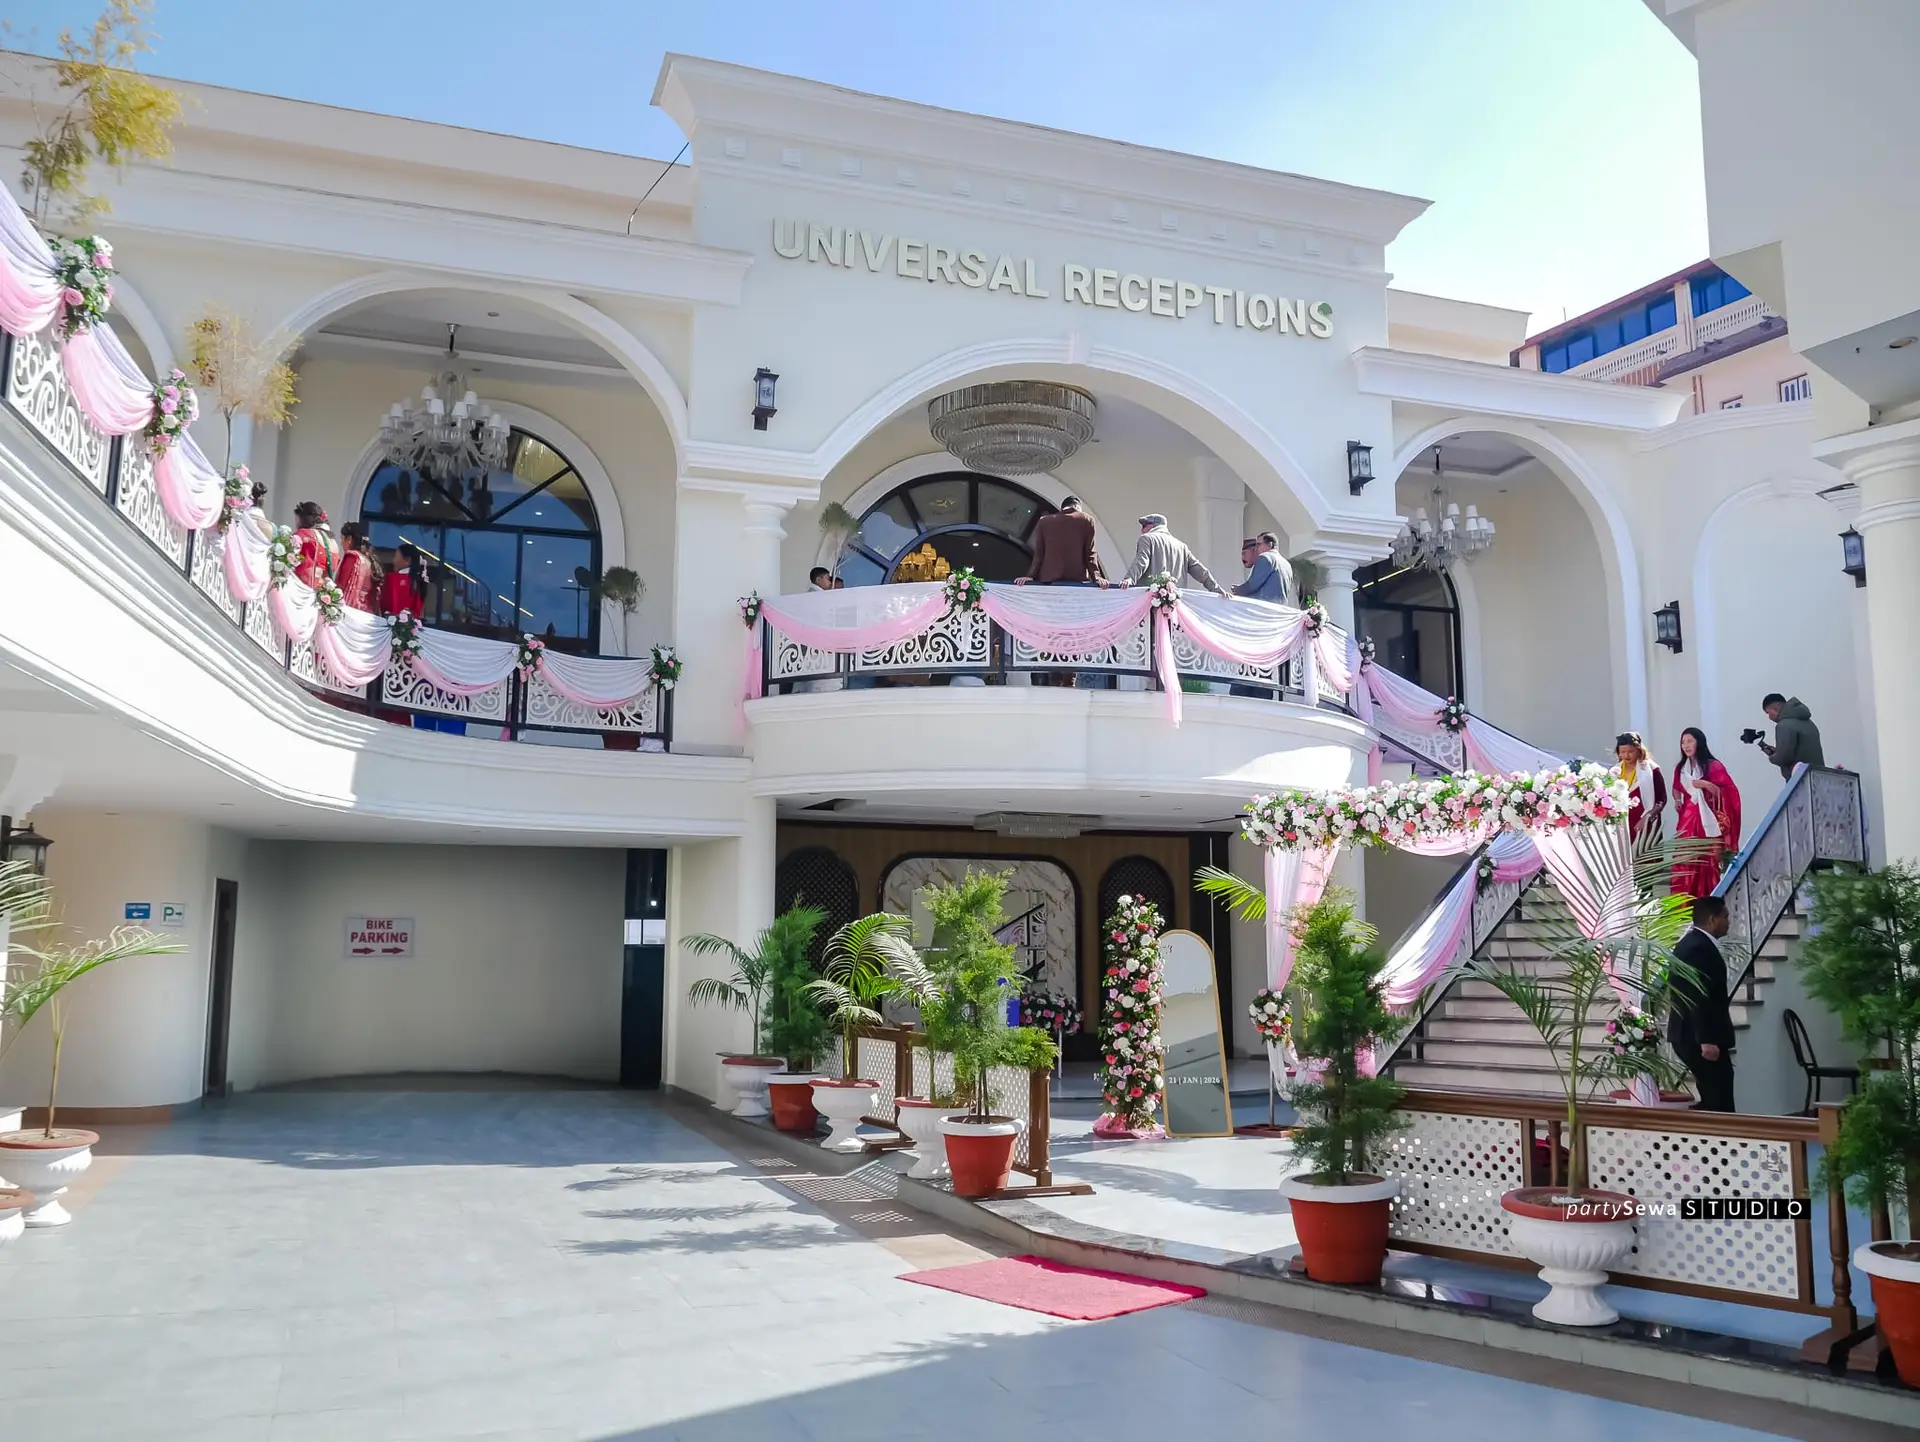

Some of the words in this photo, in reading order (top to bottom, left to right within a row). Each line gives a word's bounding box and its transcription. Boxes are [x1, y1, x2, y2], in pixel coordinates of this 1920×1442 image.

[772, 217, 1049, 298] UNIVERSAL
[1063, 263, 1334, 339] RECEPTIONS
[366, 920, 393, 930] BIKE
[350, 932, 408, 943] PARKING
[1182, 1076, 1198, 1084] JAN
